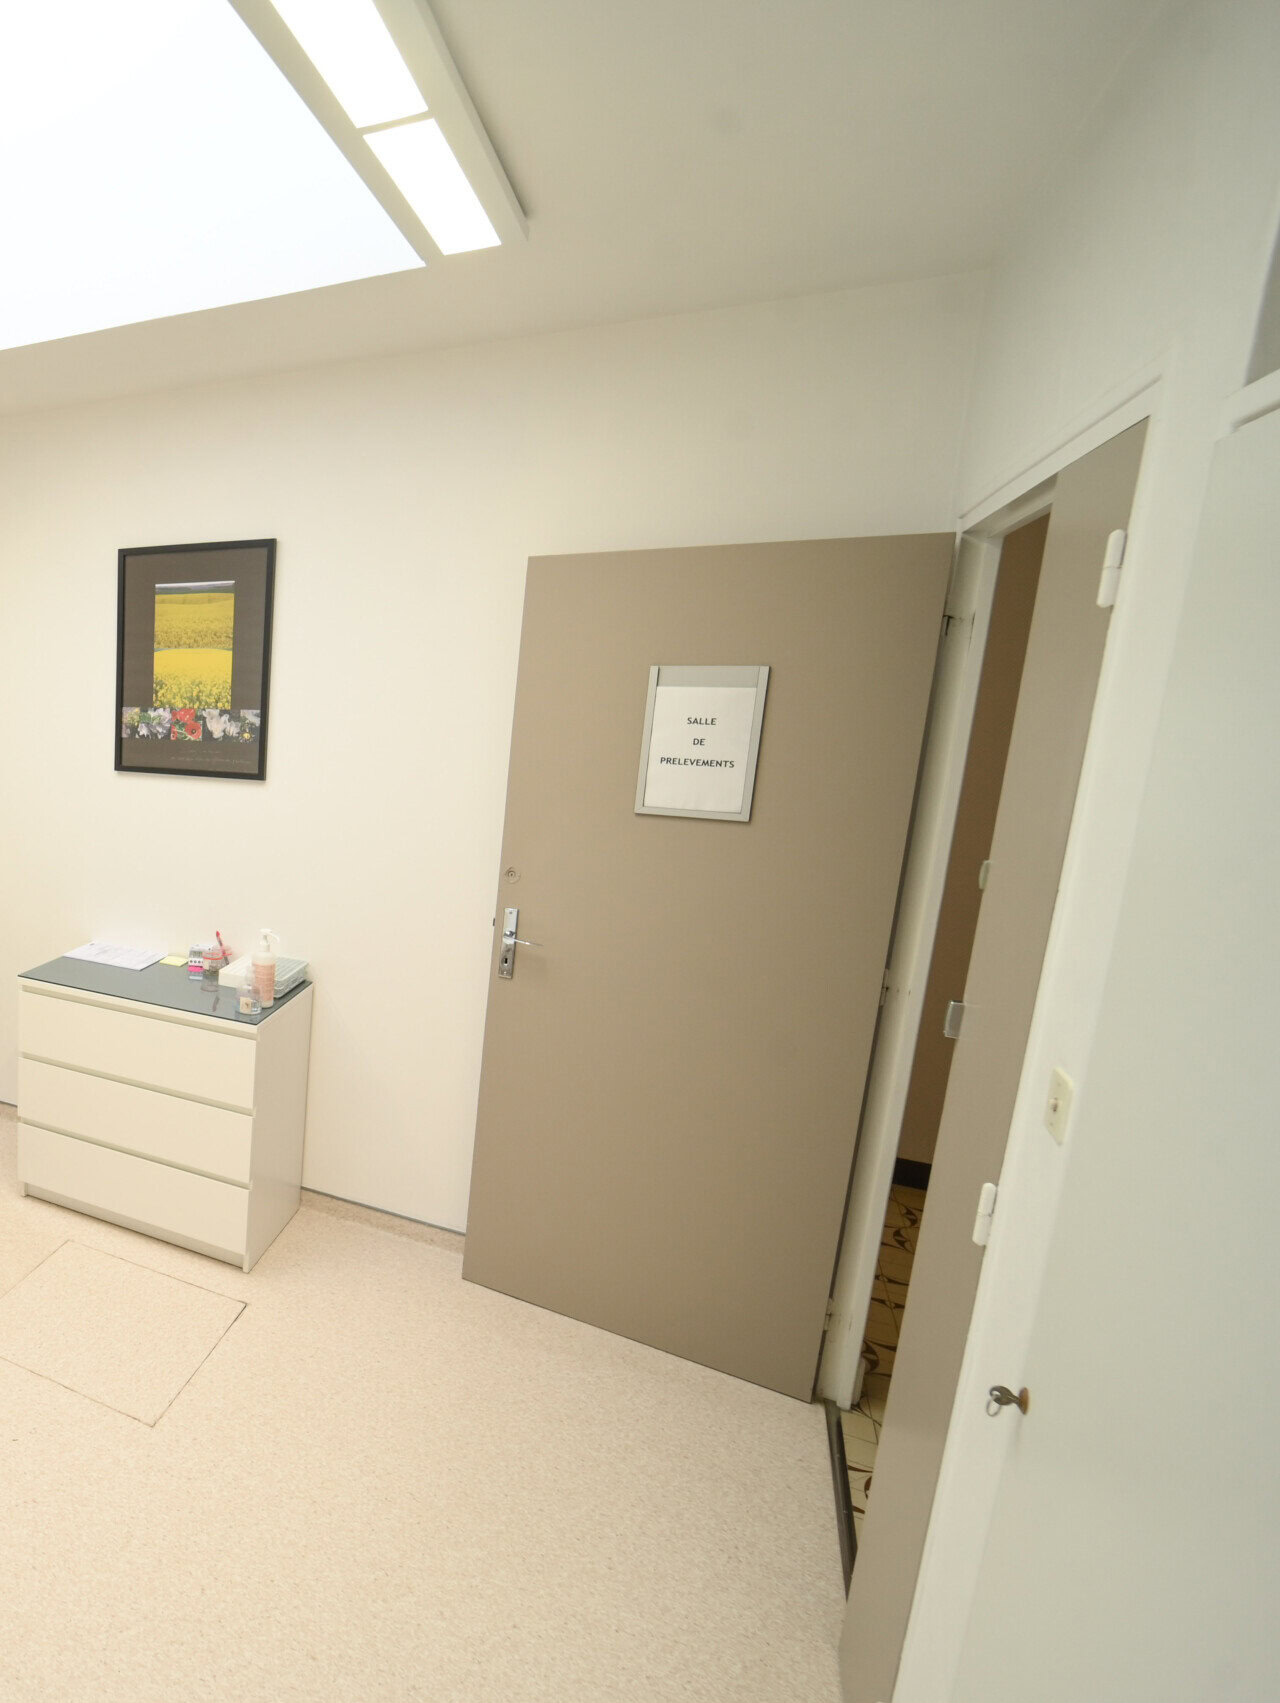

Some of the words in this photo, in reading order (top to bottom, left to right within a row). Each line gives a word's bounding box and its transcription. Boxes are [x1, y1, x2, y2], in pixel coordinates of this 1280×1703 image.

[687, 717, 717, 726] SALLE
[692, 738, 706, 746] DE
[660, 757, 735, 769] PRELEVEMENTS
